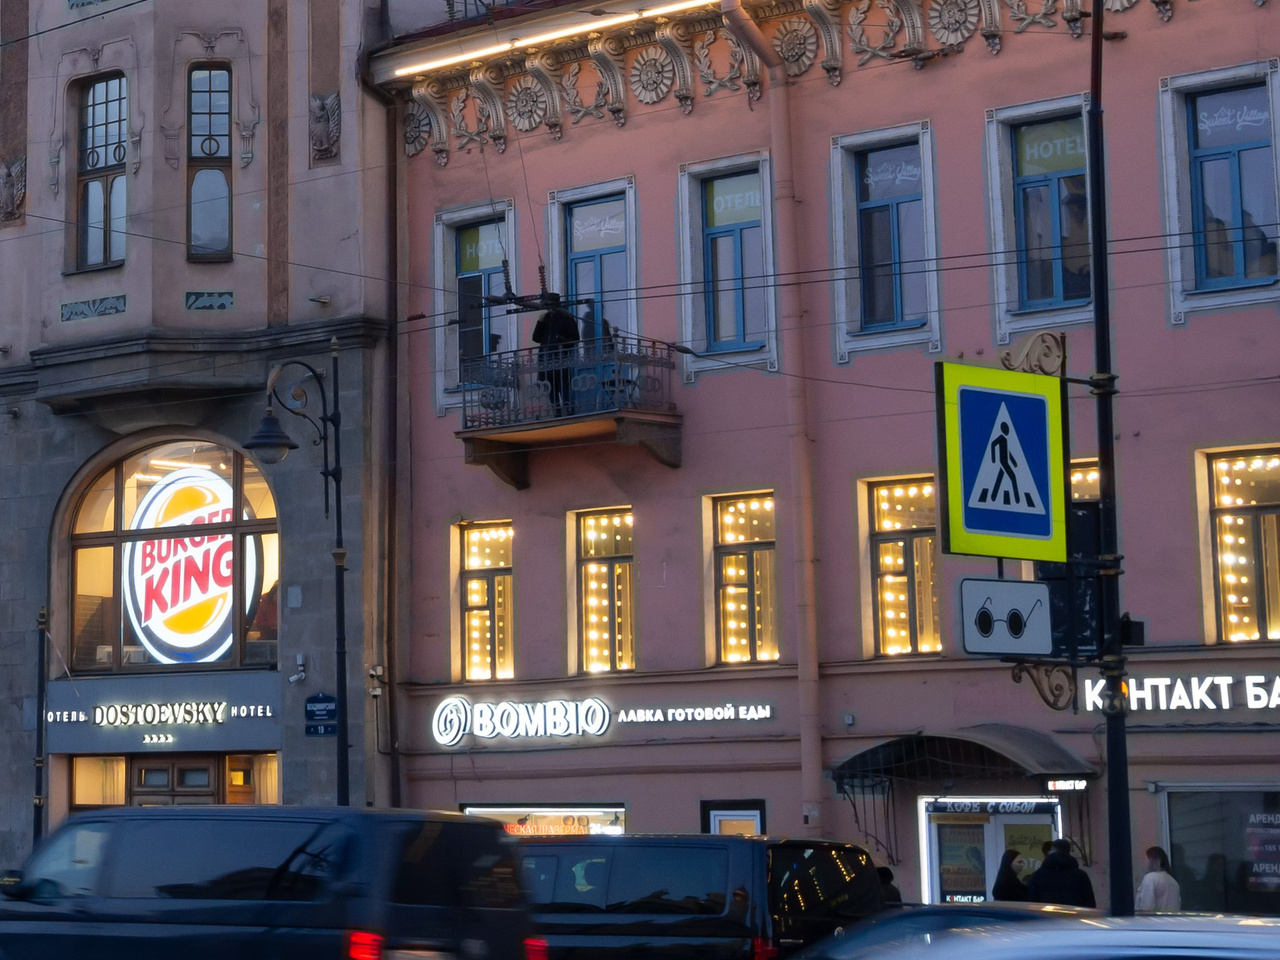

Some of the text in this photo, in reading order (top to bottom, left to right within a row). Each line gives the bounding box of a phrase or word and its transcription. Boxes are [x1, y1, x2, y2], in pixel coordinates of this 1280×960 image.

[466, 239, 502, 259] HOTE
[144, 541, 234, 624] KING
[1084, 677, 1233, 712] КНТАКТ
[47, 700, 273, 726] ОТЕЛЬ DOSTOEVSKY HOTEL
[473, 698, 610, 738] BOMBIO
[618, 703, 771, 723] ЛАВКА ГОТОВОЙ ЕДЫ
